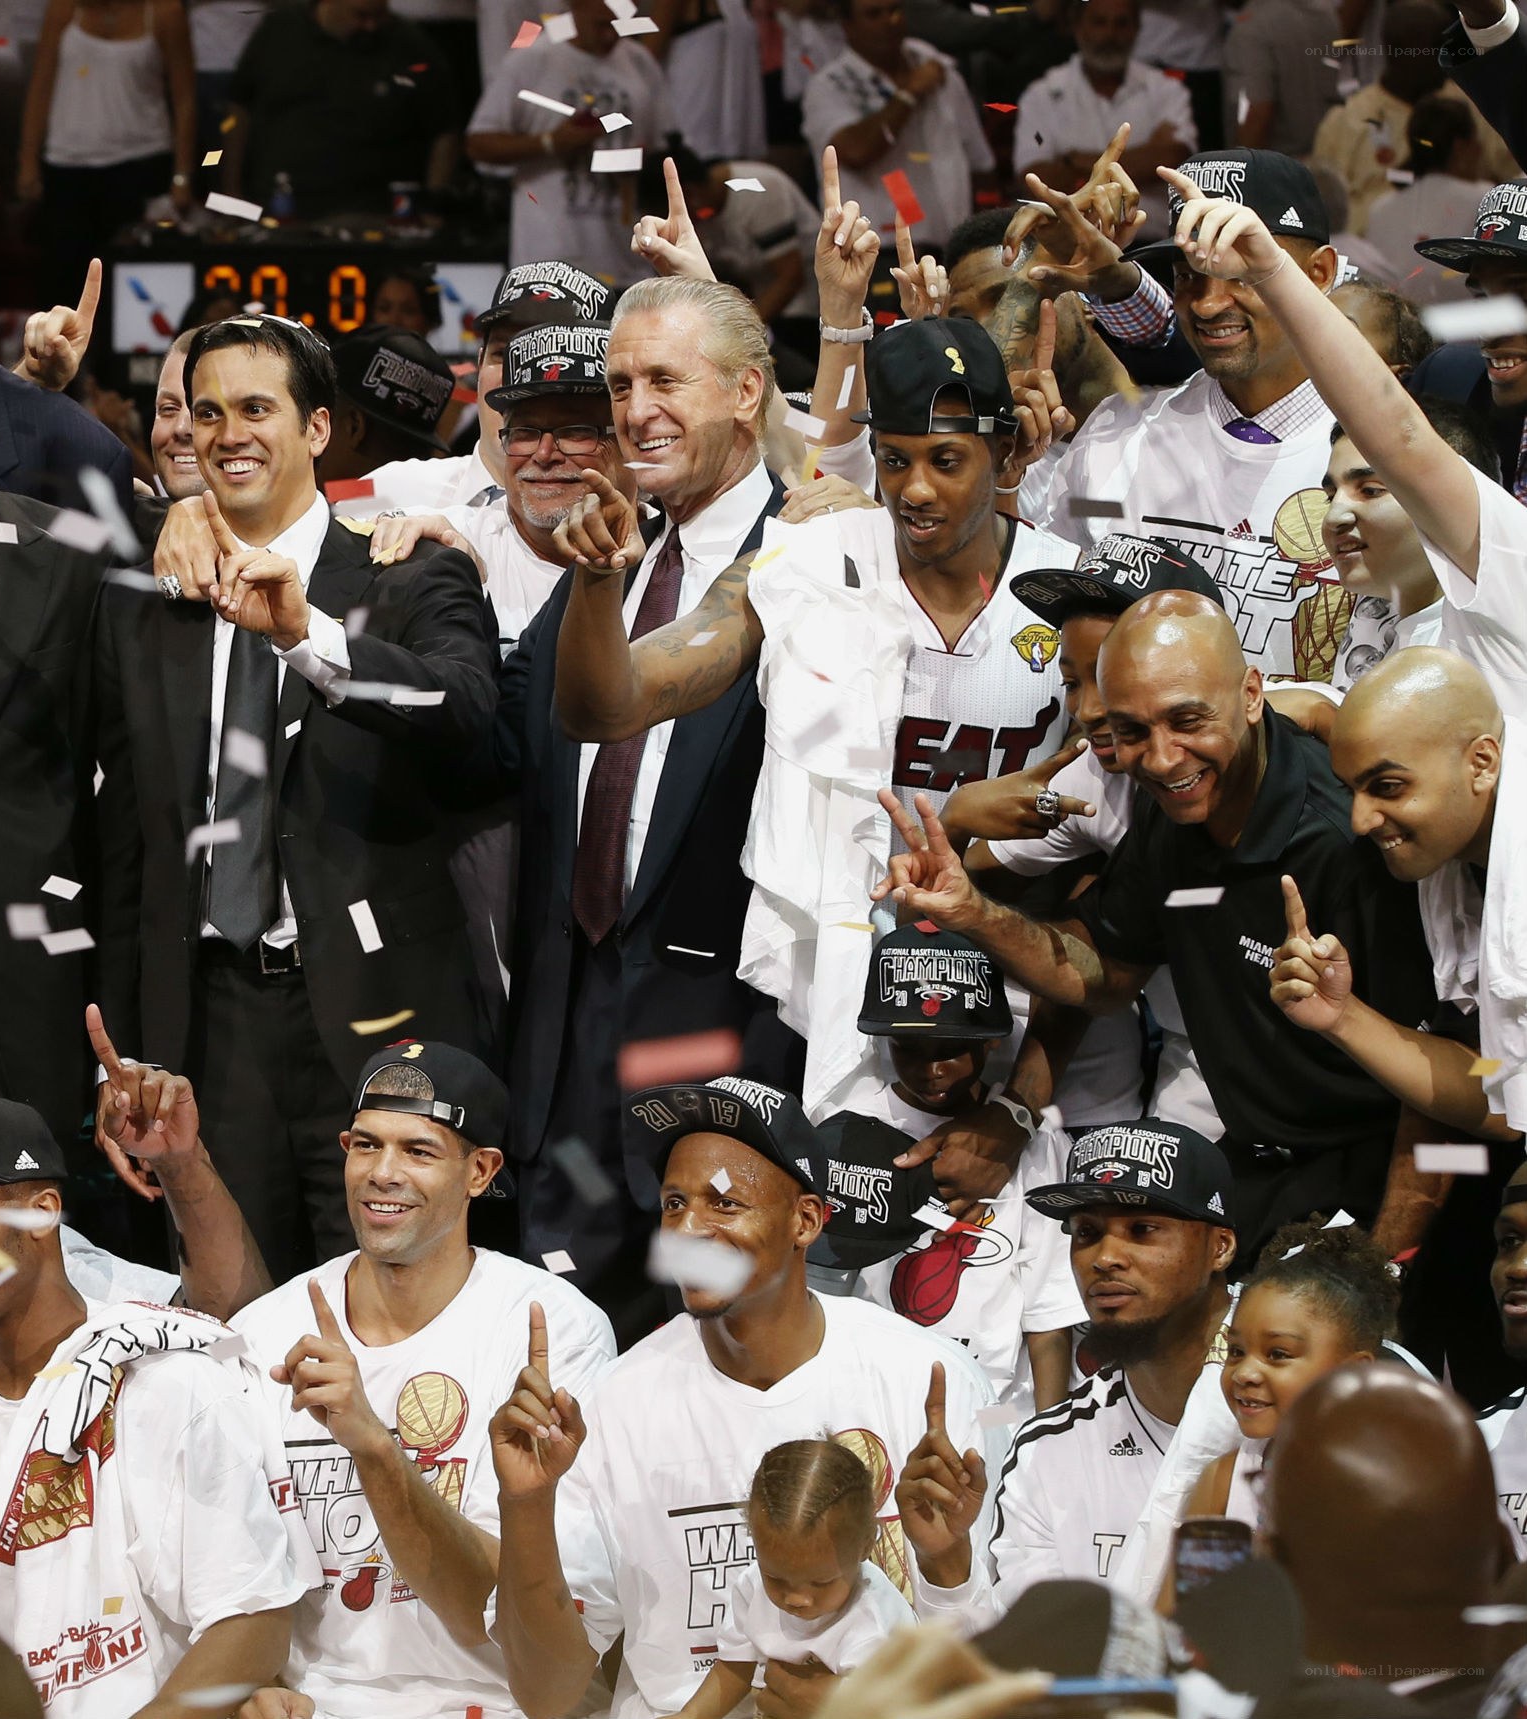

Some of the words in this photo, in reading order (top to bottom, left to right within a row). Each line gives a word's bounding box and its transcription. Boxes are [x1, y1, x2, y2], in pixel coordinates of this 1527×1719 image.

[1202, 160, 1247, 169] ASSOCIATION
[1279, 218, 1304, 229] adidas
[573, 327, 611, 336] ASSOCIATIO
[1227, 531, 1257, 541] adidas
[1112, 569, 1129, 585] 13
[891, 696, 1061, 793] EAT
[881, 948, 909, 956] NATIONAL
[911, 949, 952, 957] BASKETBALL
[1239, 935, 1273, 957] MIAM
[879, 957, 992, 1007] CHAMPIONS
[895, 990, 908, 1007] 20
[631, 1100, 679, 1132] 20
[709, 1097, 741, 1128] 13
[1132, 1128, 1180, 1144] ASSOCIATION
[15, 1162, 39, 1170] adidas
[848, 1164, 892, 1178] ASSOCIATION
[1137, 1170, 1151, 1187] 13
[827, 1168, 892, 1223] PIONS
[855, 1207, 867, 1224] 13
